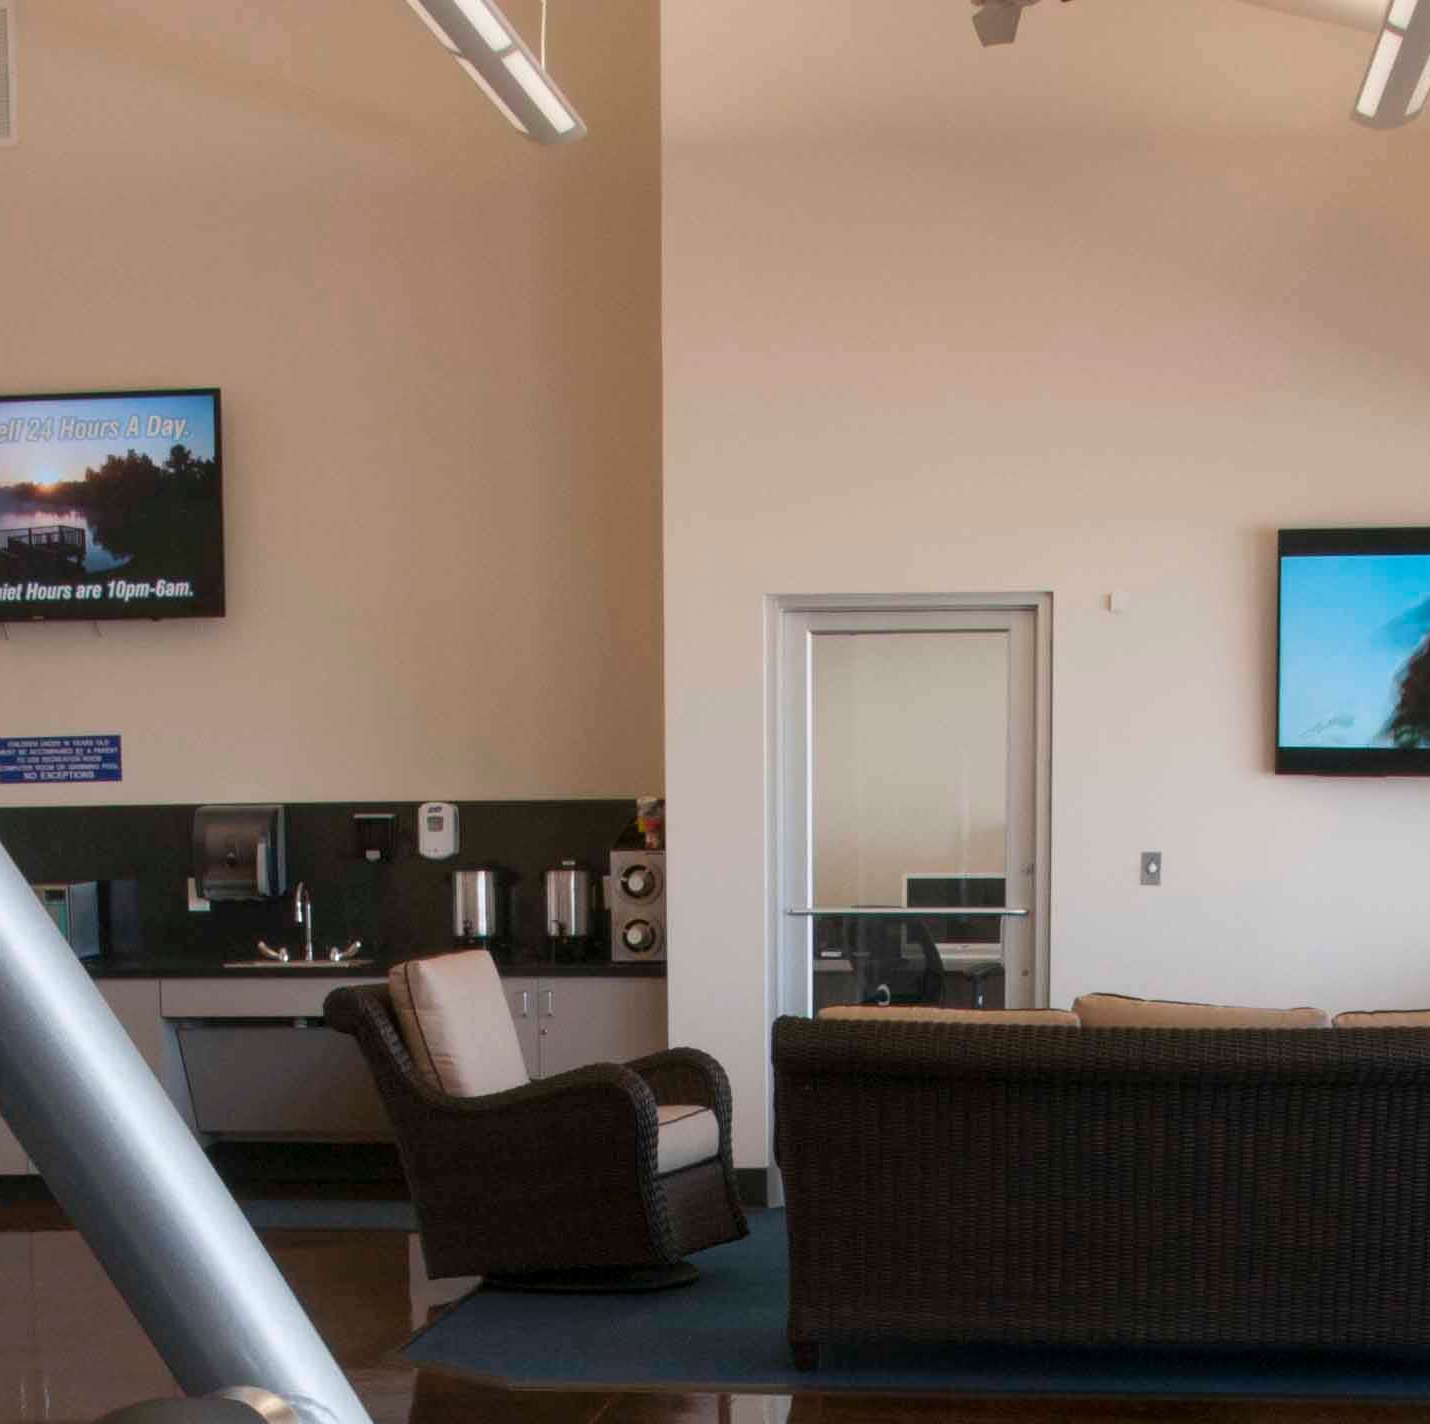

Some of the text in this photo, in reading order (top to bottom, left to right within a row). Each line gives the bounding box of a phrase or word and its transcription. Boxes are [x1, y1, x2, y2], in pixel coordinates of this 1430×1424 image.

[26, 416, 52, 443] 24
[58, 414, 120, 442] Hours
[124, 413, 141, 439] A
[26, 581, 72, 601] Hours
[75, 584, 103, 600] are
[107, 579, 194, 602] 10pm-6am.
